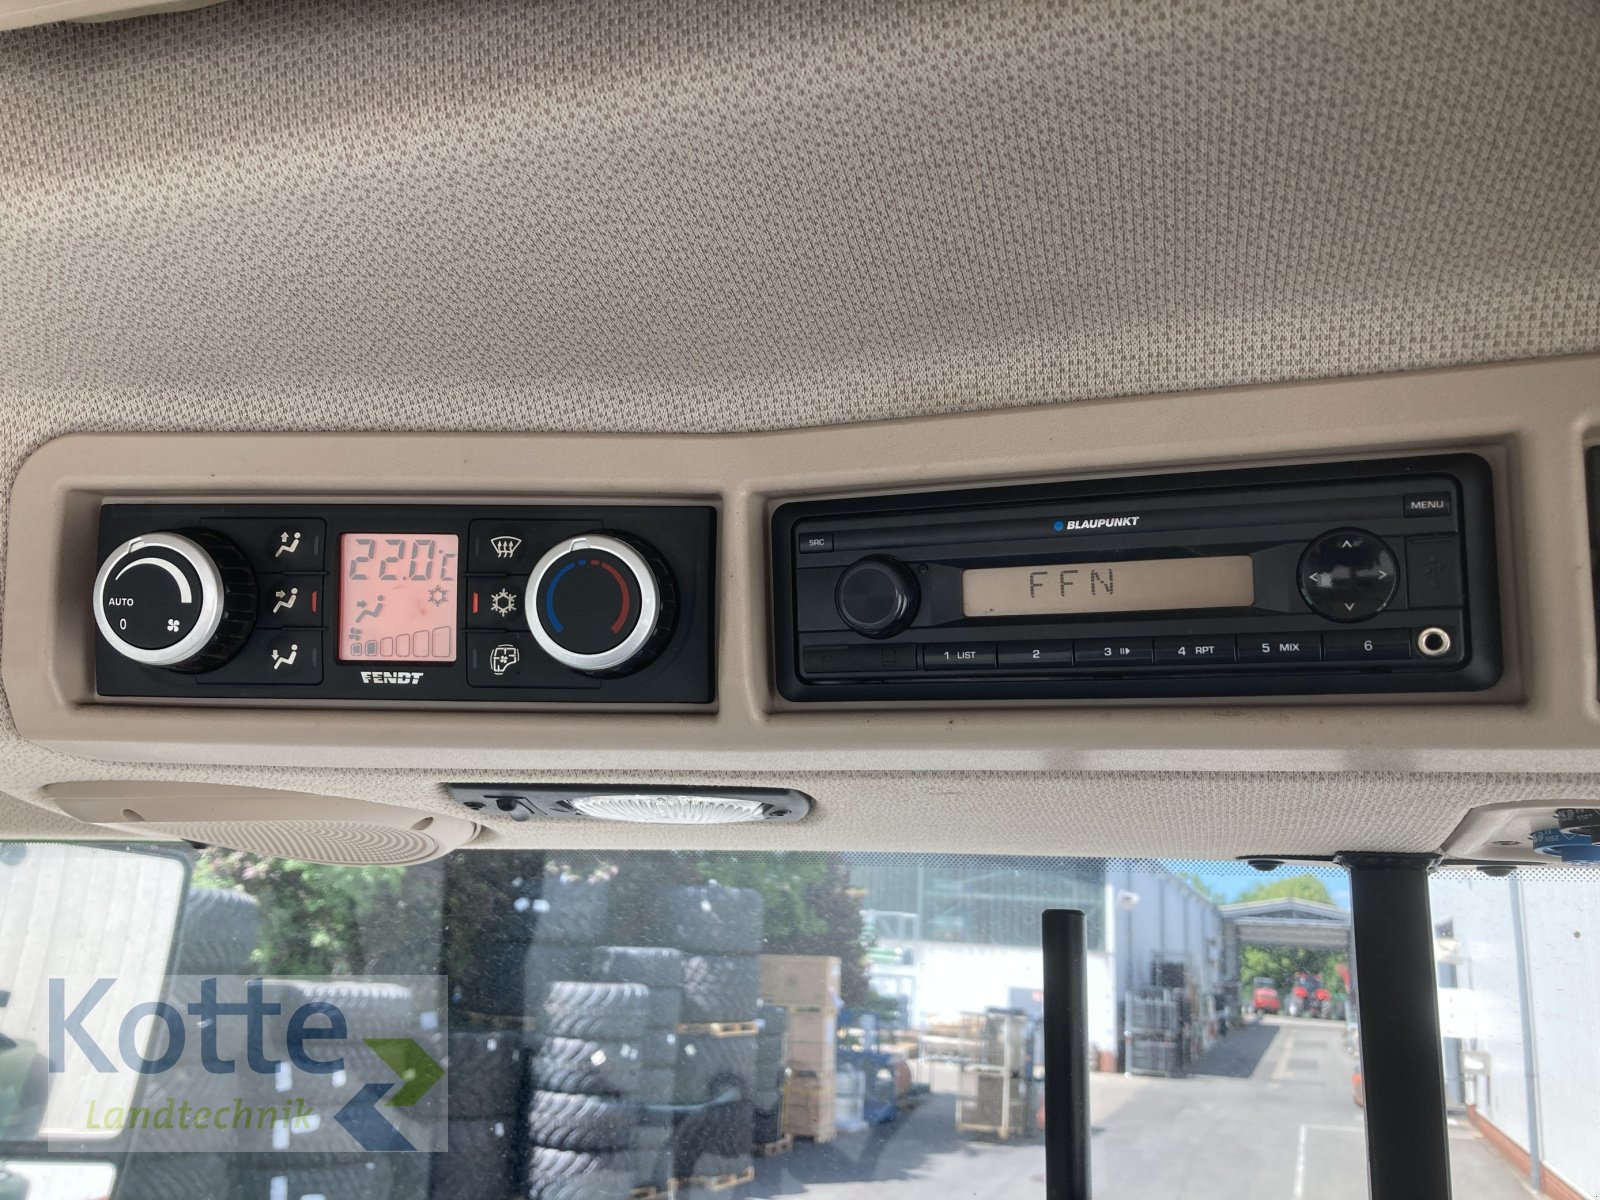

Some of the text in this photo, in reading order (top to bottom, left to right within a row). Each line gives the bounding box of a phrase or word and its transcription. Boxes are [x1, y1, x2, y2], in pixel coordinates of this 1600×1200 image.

[1410, 500, 1444, 509] MENU
[1066, 516, 1139, 530] BLAUPUNKT
[809, 538, 824, 546] SRC
[1030, 568, 1112, 598] FFN
[108, 598, 134, 606] AUTO
[120, 618, 126, 630] 0
[1262, 642, 1300, 652] 5 MIX
[1364, 640, 1372, 651] 6
[944, 651, 976, 660] 1 LIST
[1032, 650, 1040, 658] 2
[1104, 647, 1112, 656] 3
[1178, 646, 1215, 656] 4 RPT
[360, 672, 424, 684] FENDT
